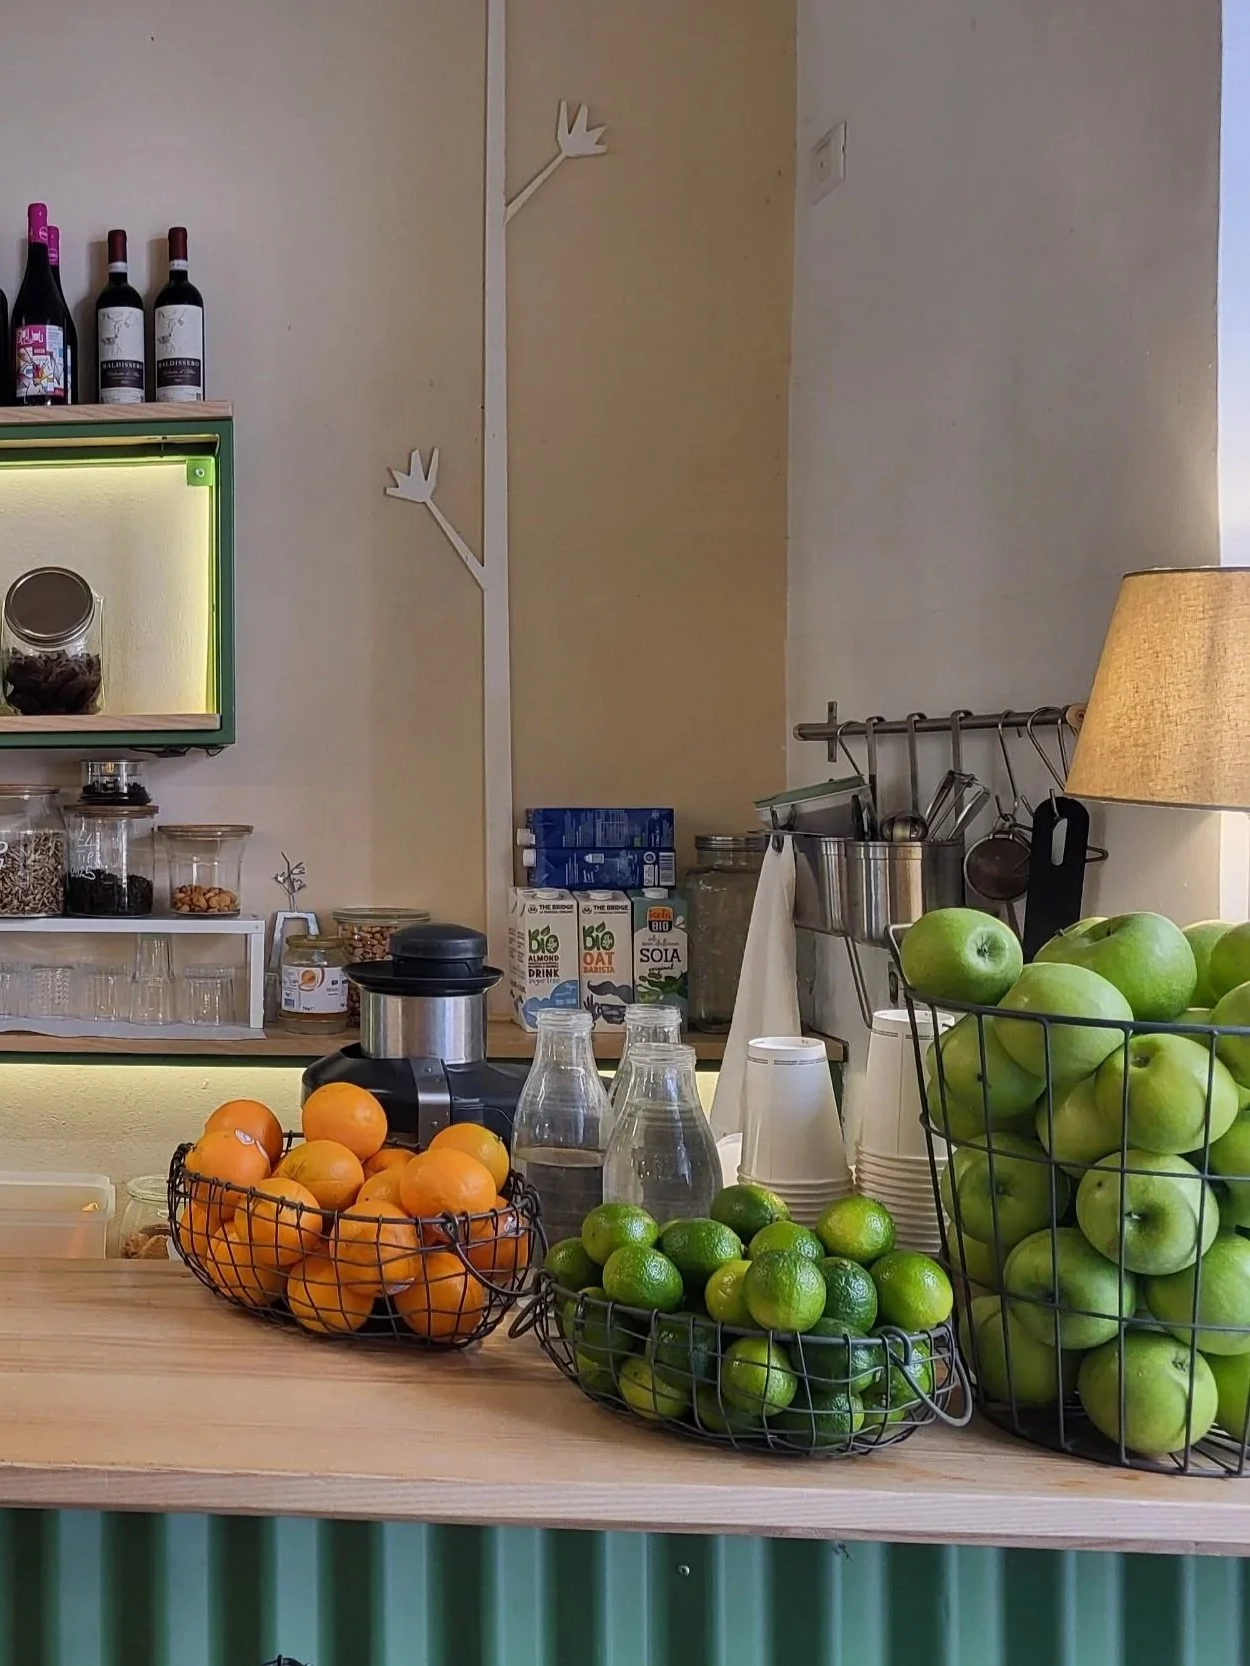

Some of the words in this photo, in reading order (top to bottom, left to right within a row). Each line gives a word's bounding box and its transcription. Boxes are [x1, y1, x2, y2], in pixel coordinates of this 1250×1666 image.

[651, 921, 670, 932] BIO
[582, 952, 615, 966] OAT
[639, 948, 682, 963] SOIA
[528, 969, 560, 978] DRINK
[583, 966, 616, 974] BARISTA
